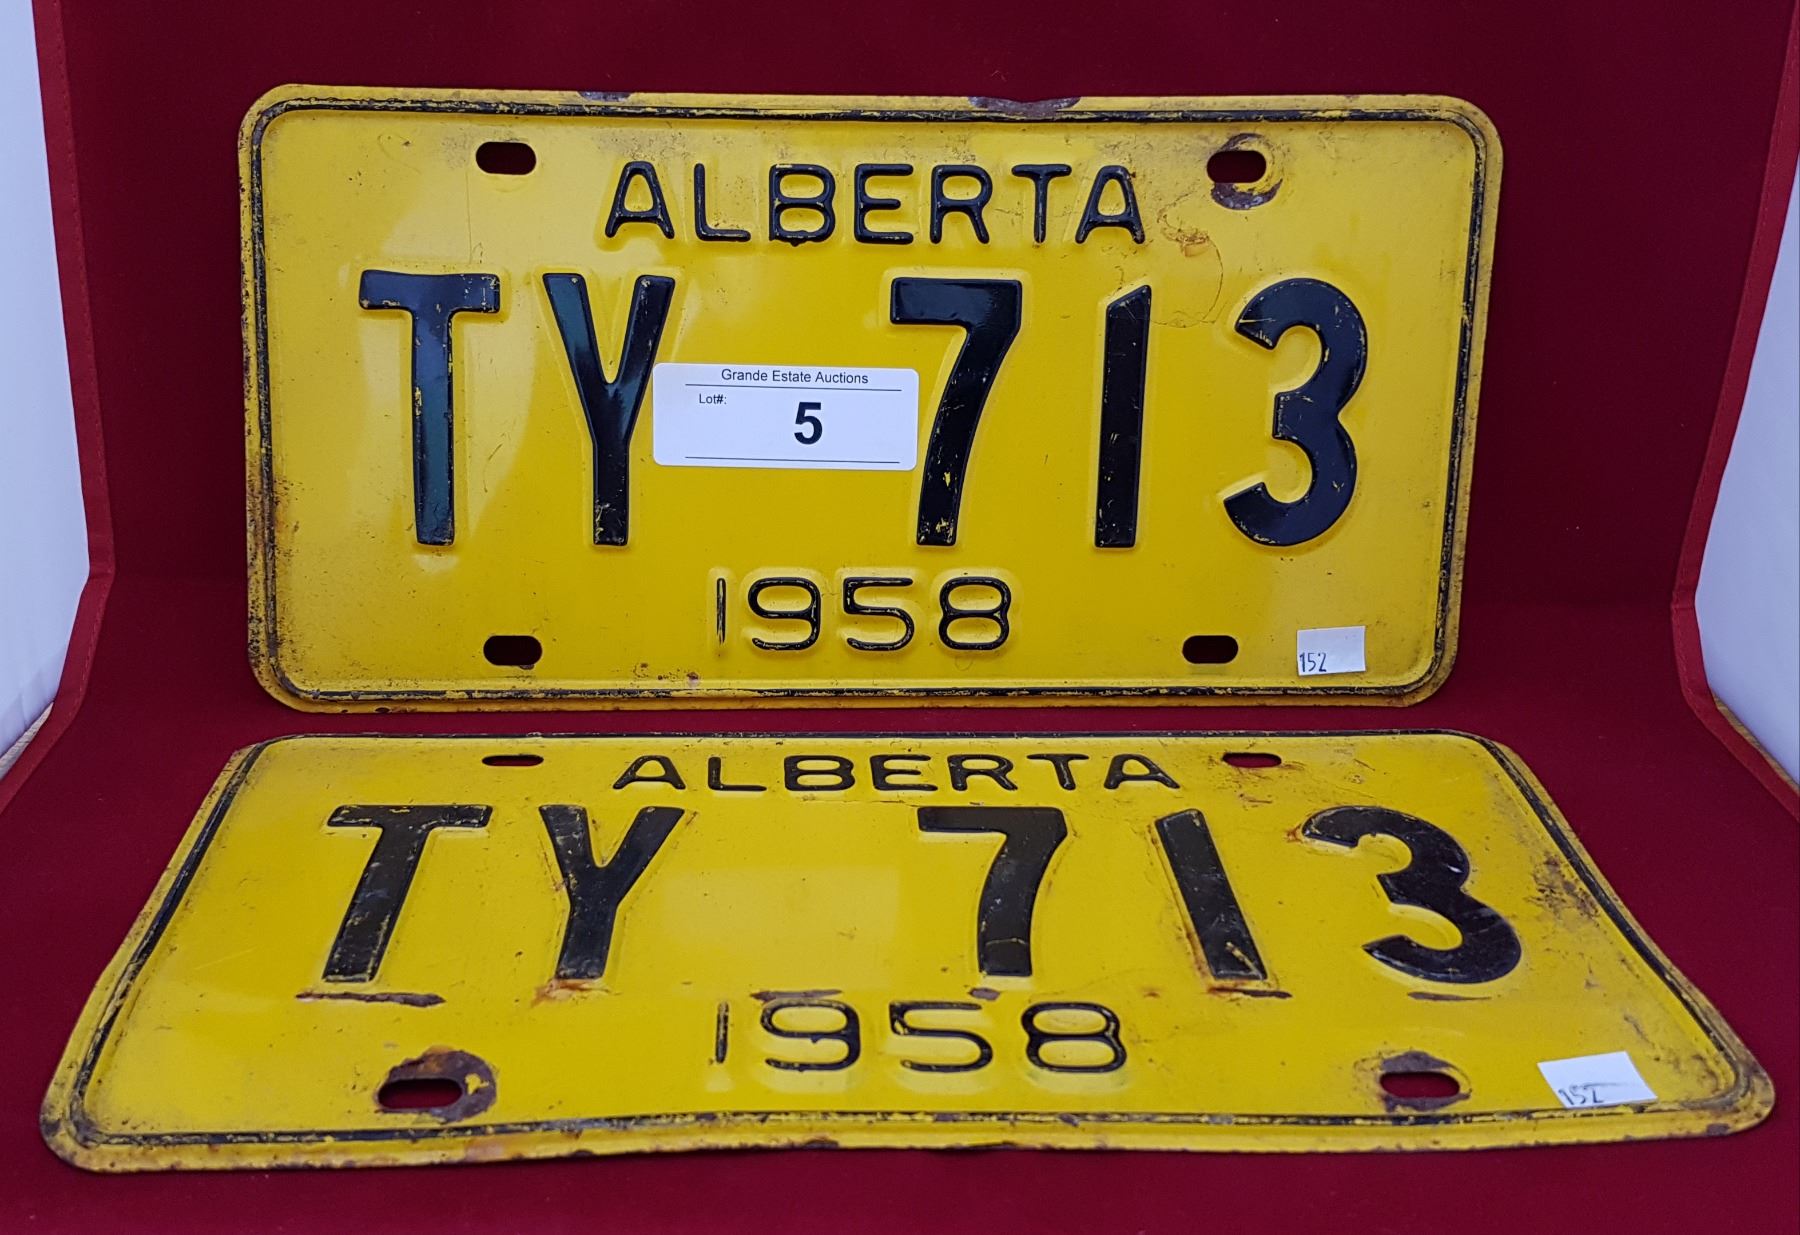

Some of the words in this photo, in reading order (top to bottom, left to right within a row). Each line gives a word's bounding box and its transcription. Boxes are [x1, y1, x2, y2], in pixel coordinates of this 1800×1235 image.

[605, 161, 1146, 245] ALBERTA
[698, 393, 727, 405] Lot#:
[721, 368, 768, 382] Grande
[772, 370, 811, 383] Estate
[815, 371, 869, 384] Auctions
[359, 269, 676, 546] TY
[889, 277, 1368, 548] 713
[794, 401, 823, 445] 5
[716, 576, 1012, 651] 1958
[1299, 652, 1327, 672] 152
[613, 753, 1181, 791] ALBERTA
[321, 804, 685, 983] TY
[916, 805, 1522, 985] 713
[715, 1000, 1128, 1074] 1958
